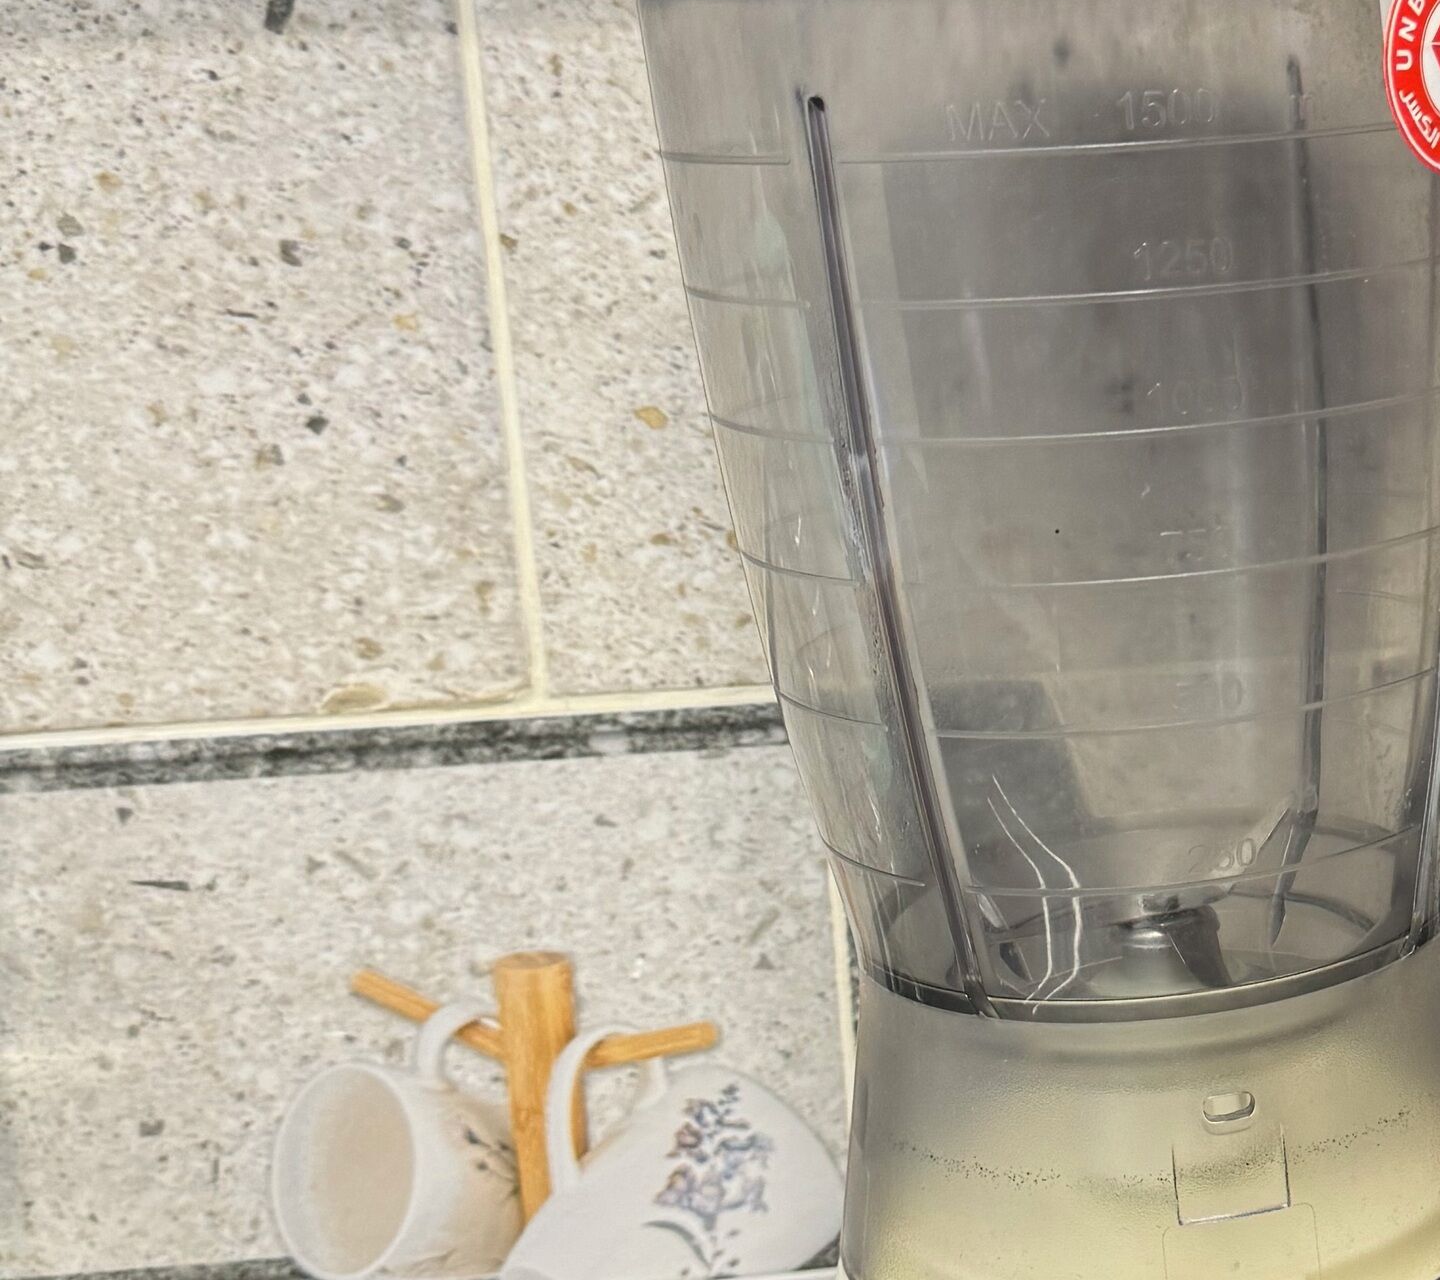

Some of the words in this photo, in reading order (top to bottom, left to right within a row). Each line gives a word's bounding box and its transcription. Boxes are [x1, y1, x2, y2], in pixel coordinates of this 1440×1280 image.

[945, 97, 1050, 141] MAX
[1116, 87, 1220, 131] 1500
[1398, 88, 1440, 149] الكسر
[1134, 234, 1235, 280] 1250
